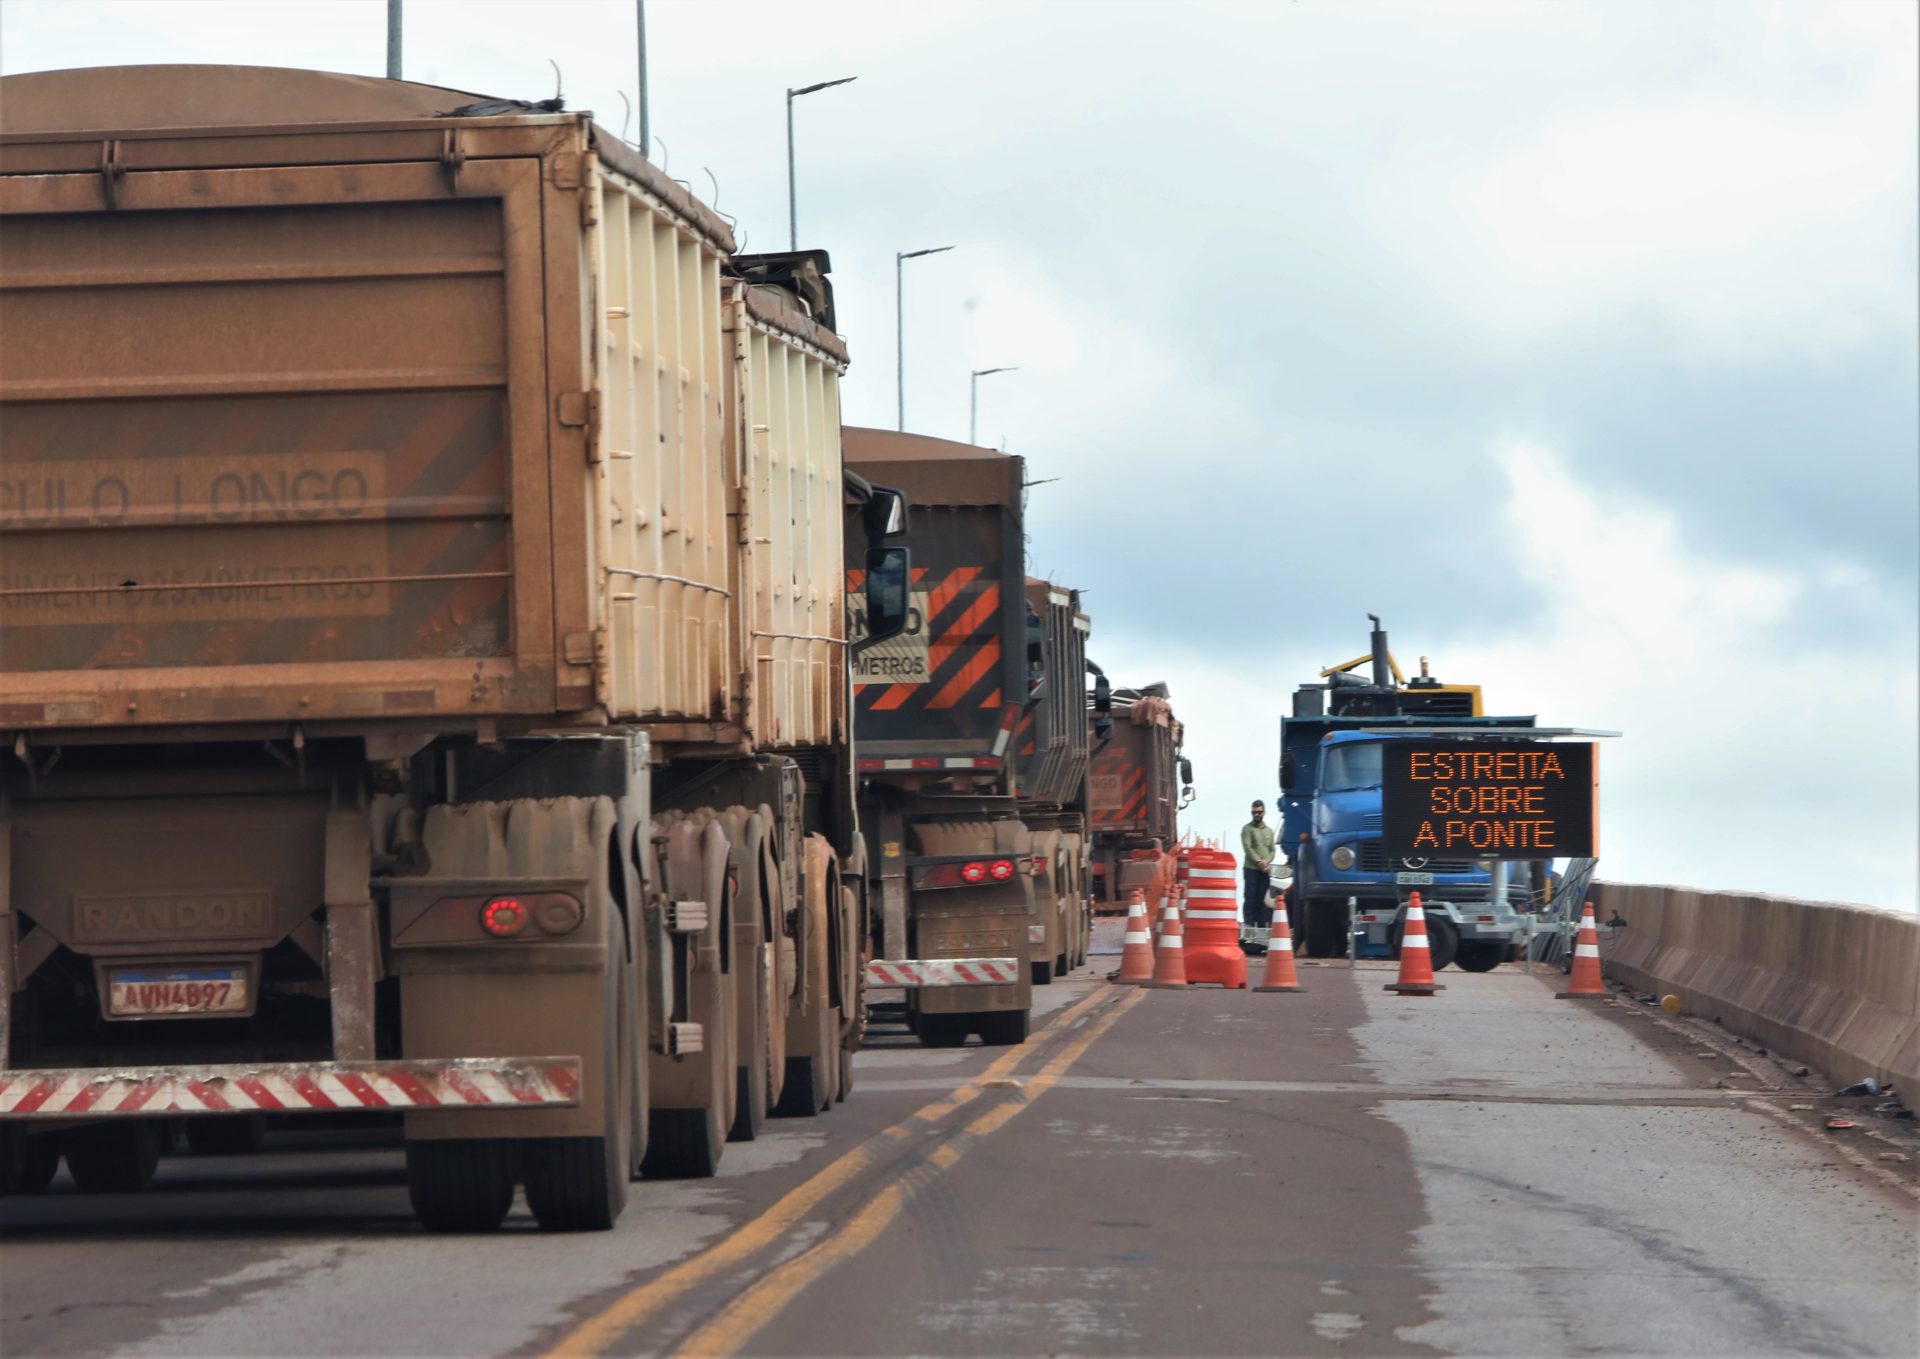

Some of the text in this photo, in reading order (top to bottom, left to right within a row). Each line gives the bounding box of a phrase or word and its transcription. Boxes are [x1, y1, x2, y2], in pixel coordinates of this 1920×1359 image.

[174, 467, 368, 524] LONGO
[856, 656, 924, 676] METROS
[1410, 752, 1565, 779] ESTREITA
[1431, 787, 1545, 813] SOBRE
[1414, 821, 1554, 847] A PONTE
[82, 901, 266, 931] RANDON
